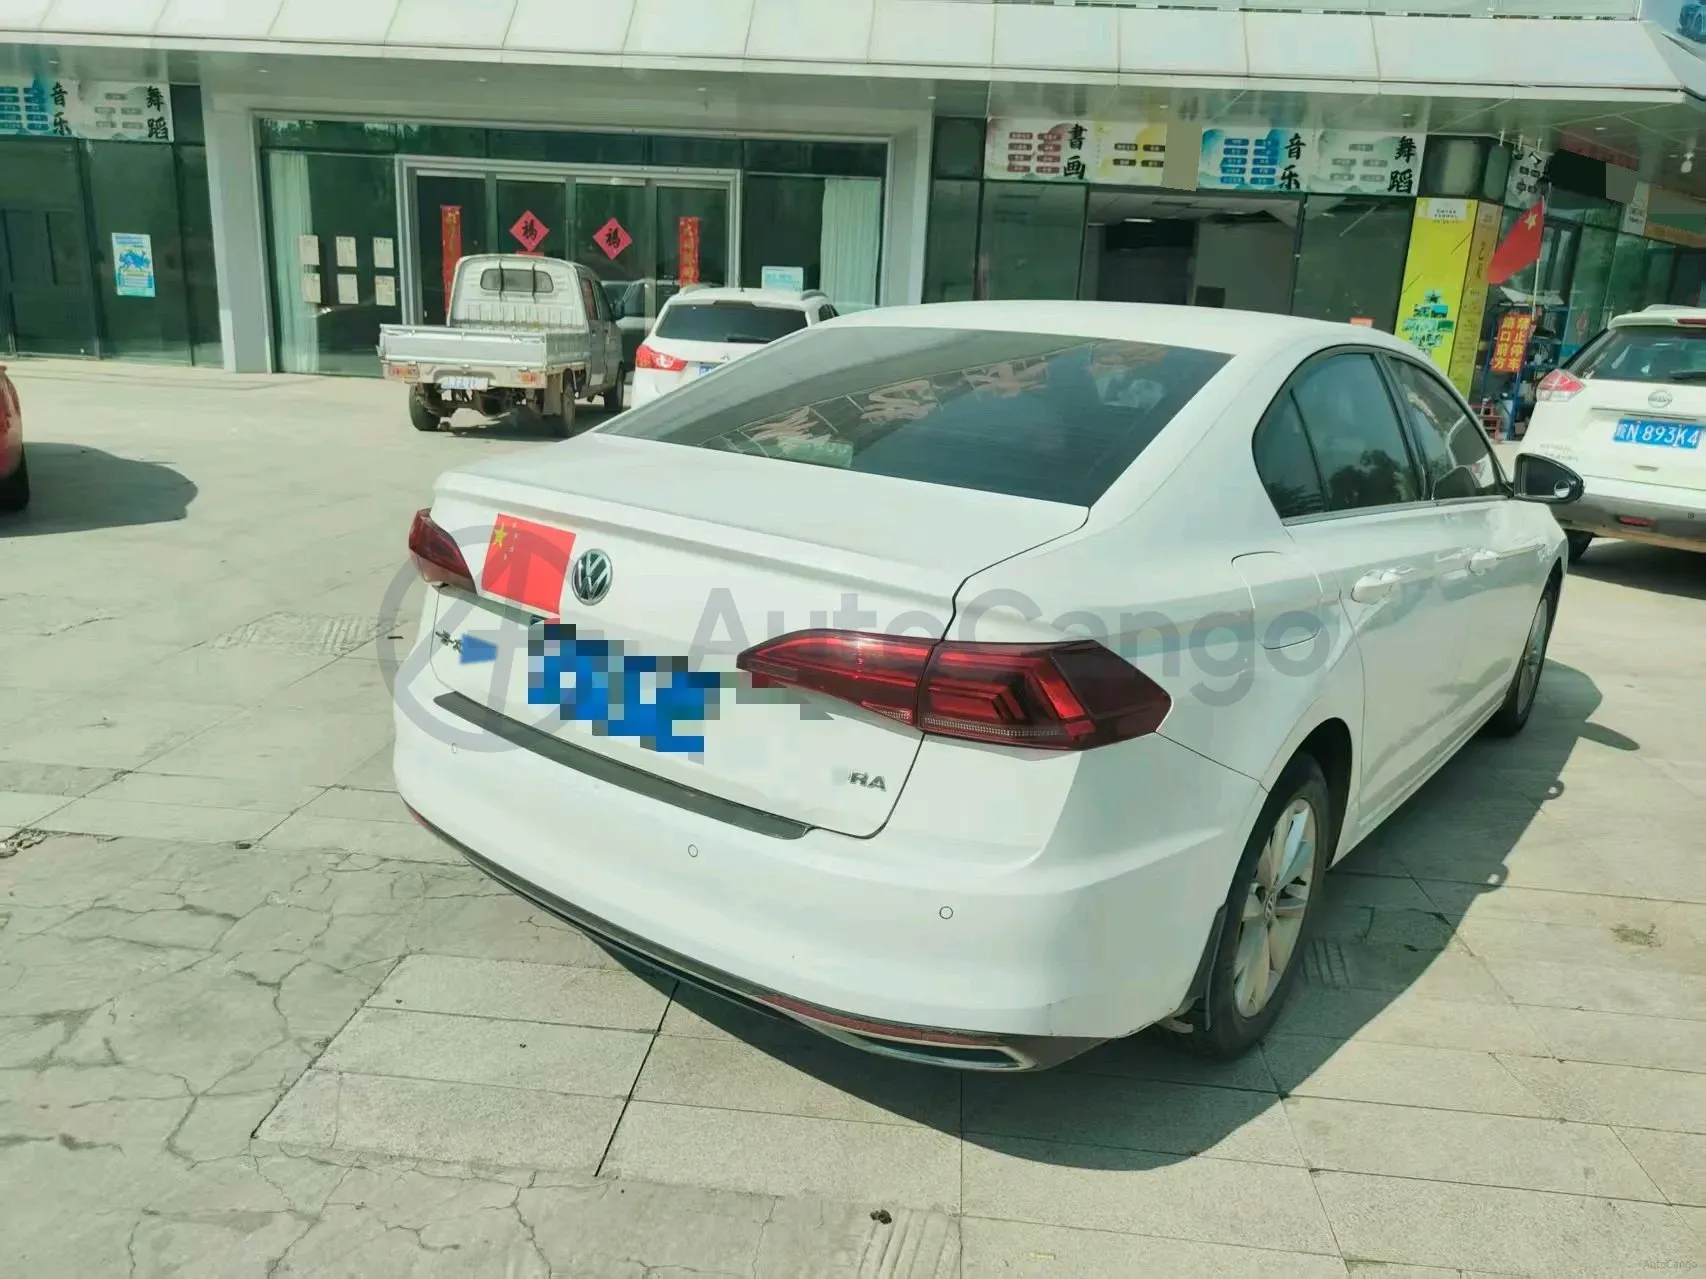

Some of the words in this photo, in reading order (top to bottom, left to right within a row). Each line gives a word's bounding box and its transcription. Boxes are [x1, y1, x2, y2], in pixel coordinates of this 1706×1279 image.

[51, 82, 73, 136] 音乐
[146, 85, 169, 139] 舞蹈
[1279, 133, 1307, 190] 音乐
[1387, 135, 1417, 194] 舞蹈
[522, 219, 539, 241] 福
[605, 227, 621, 249] 福
